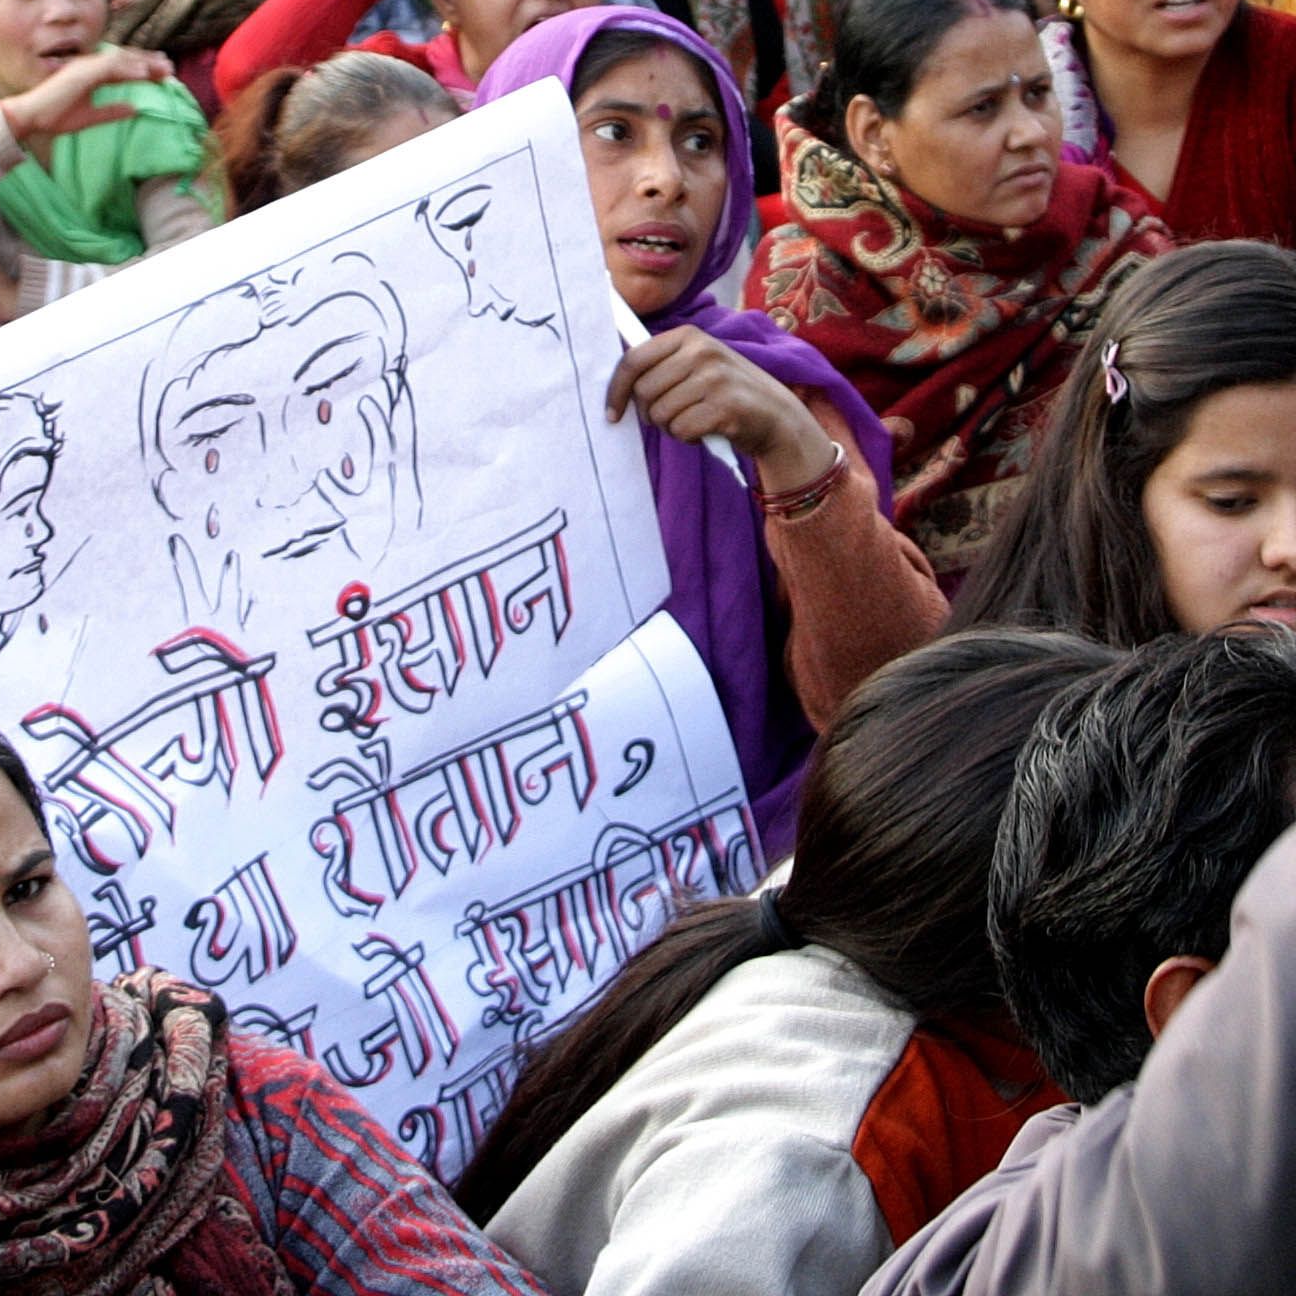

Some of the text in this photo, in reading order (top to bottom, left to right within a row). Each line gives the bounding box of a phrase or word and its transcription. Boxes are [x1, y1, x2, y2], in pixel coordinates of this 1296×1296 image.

[21, 507, 574, 876] सोचो इंसान
[184, 851, 298, 987] या
[323, 932, 458, 1087] जो
